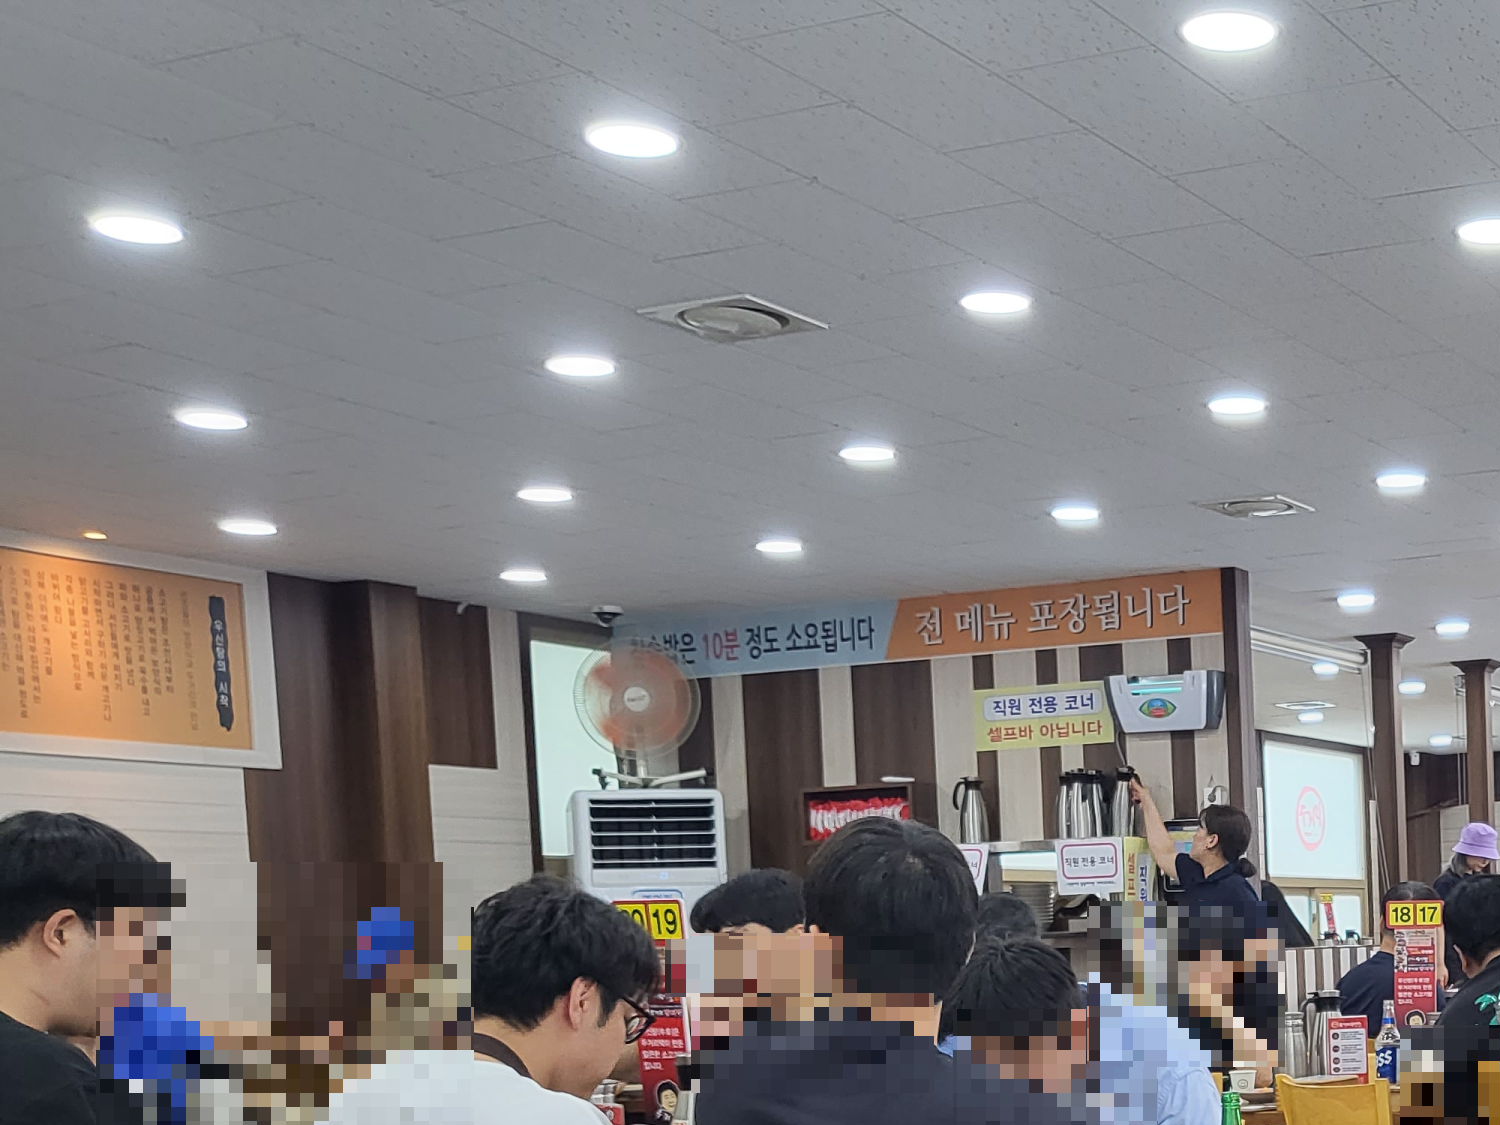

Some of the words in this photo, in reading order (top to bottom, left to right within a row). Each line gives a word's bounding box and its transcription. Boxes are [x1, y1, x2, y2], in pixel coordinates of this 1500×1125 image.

[916, 606, 944, 646] 전
[954, 601, 1017, 643] 메뉴
[1027, 584, 1191, 635] 포장됩니다
[213, 619, 226, 672] 우신탕의
[702, 628, 740, 662] 10분
[745, 625, 781, 659] 정도
[785, 615, 876, 654] 소요됩니다
[218, 681, 229, 707] 시작
[992, 697, 1022, 717] 직원
[1028, 695, 1058, 715] 전용
[1064, 692, 1095, 711] 코너
[987, 724, 1034, 743] 셀프바
[1040, 720, 1103, 739] 아닙니다
[1065, 857, 1079, 868] 직원
[1081, 856, 1097, 867] 전용
[1098, 856, 1114, 865] 코너
[1127, 853, 1136, 896] 셀프
[617, 909, 645, 929] 0
[652, 908, 678, 935] 19
[1391, 906, 1411, 923] 18
[1419, 906, 1438, 923] 17
